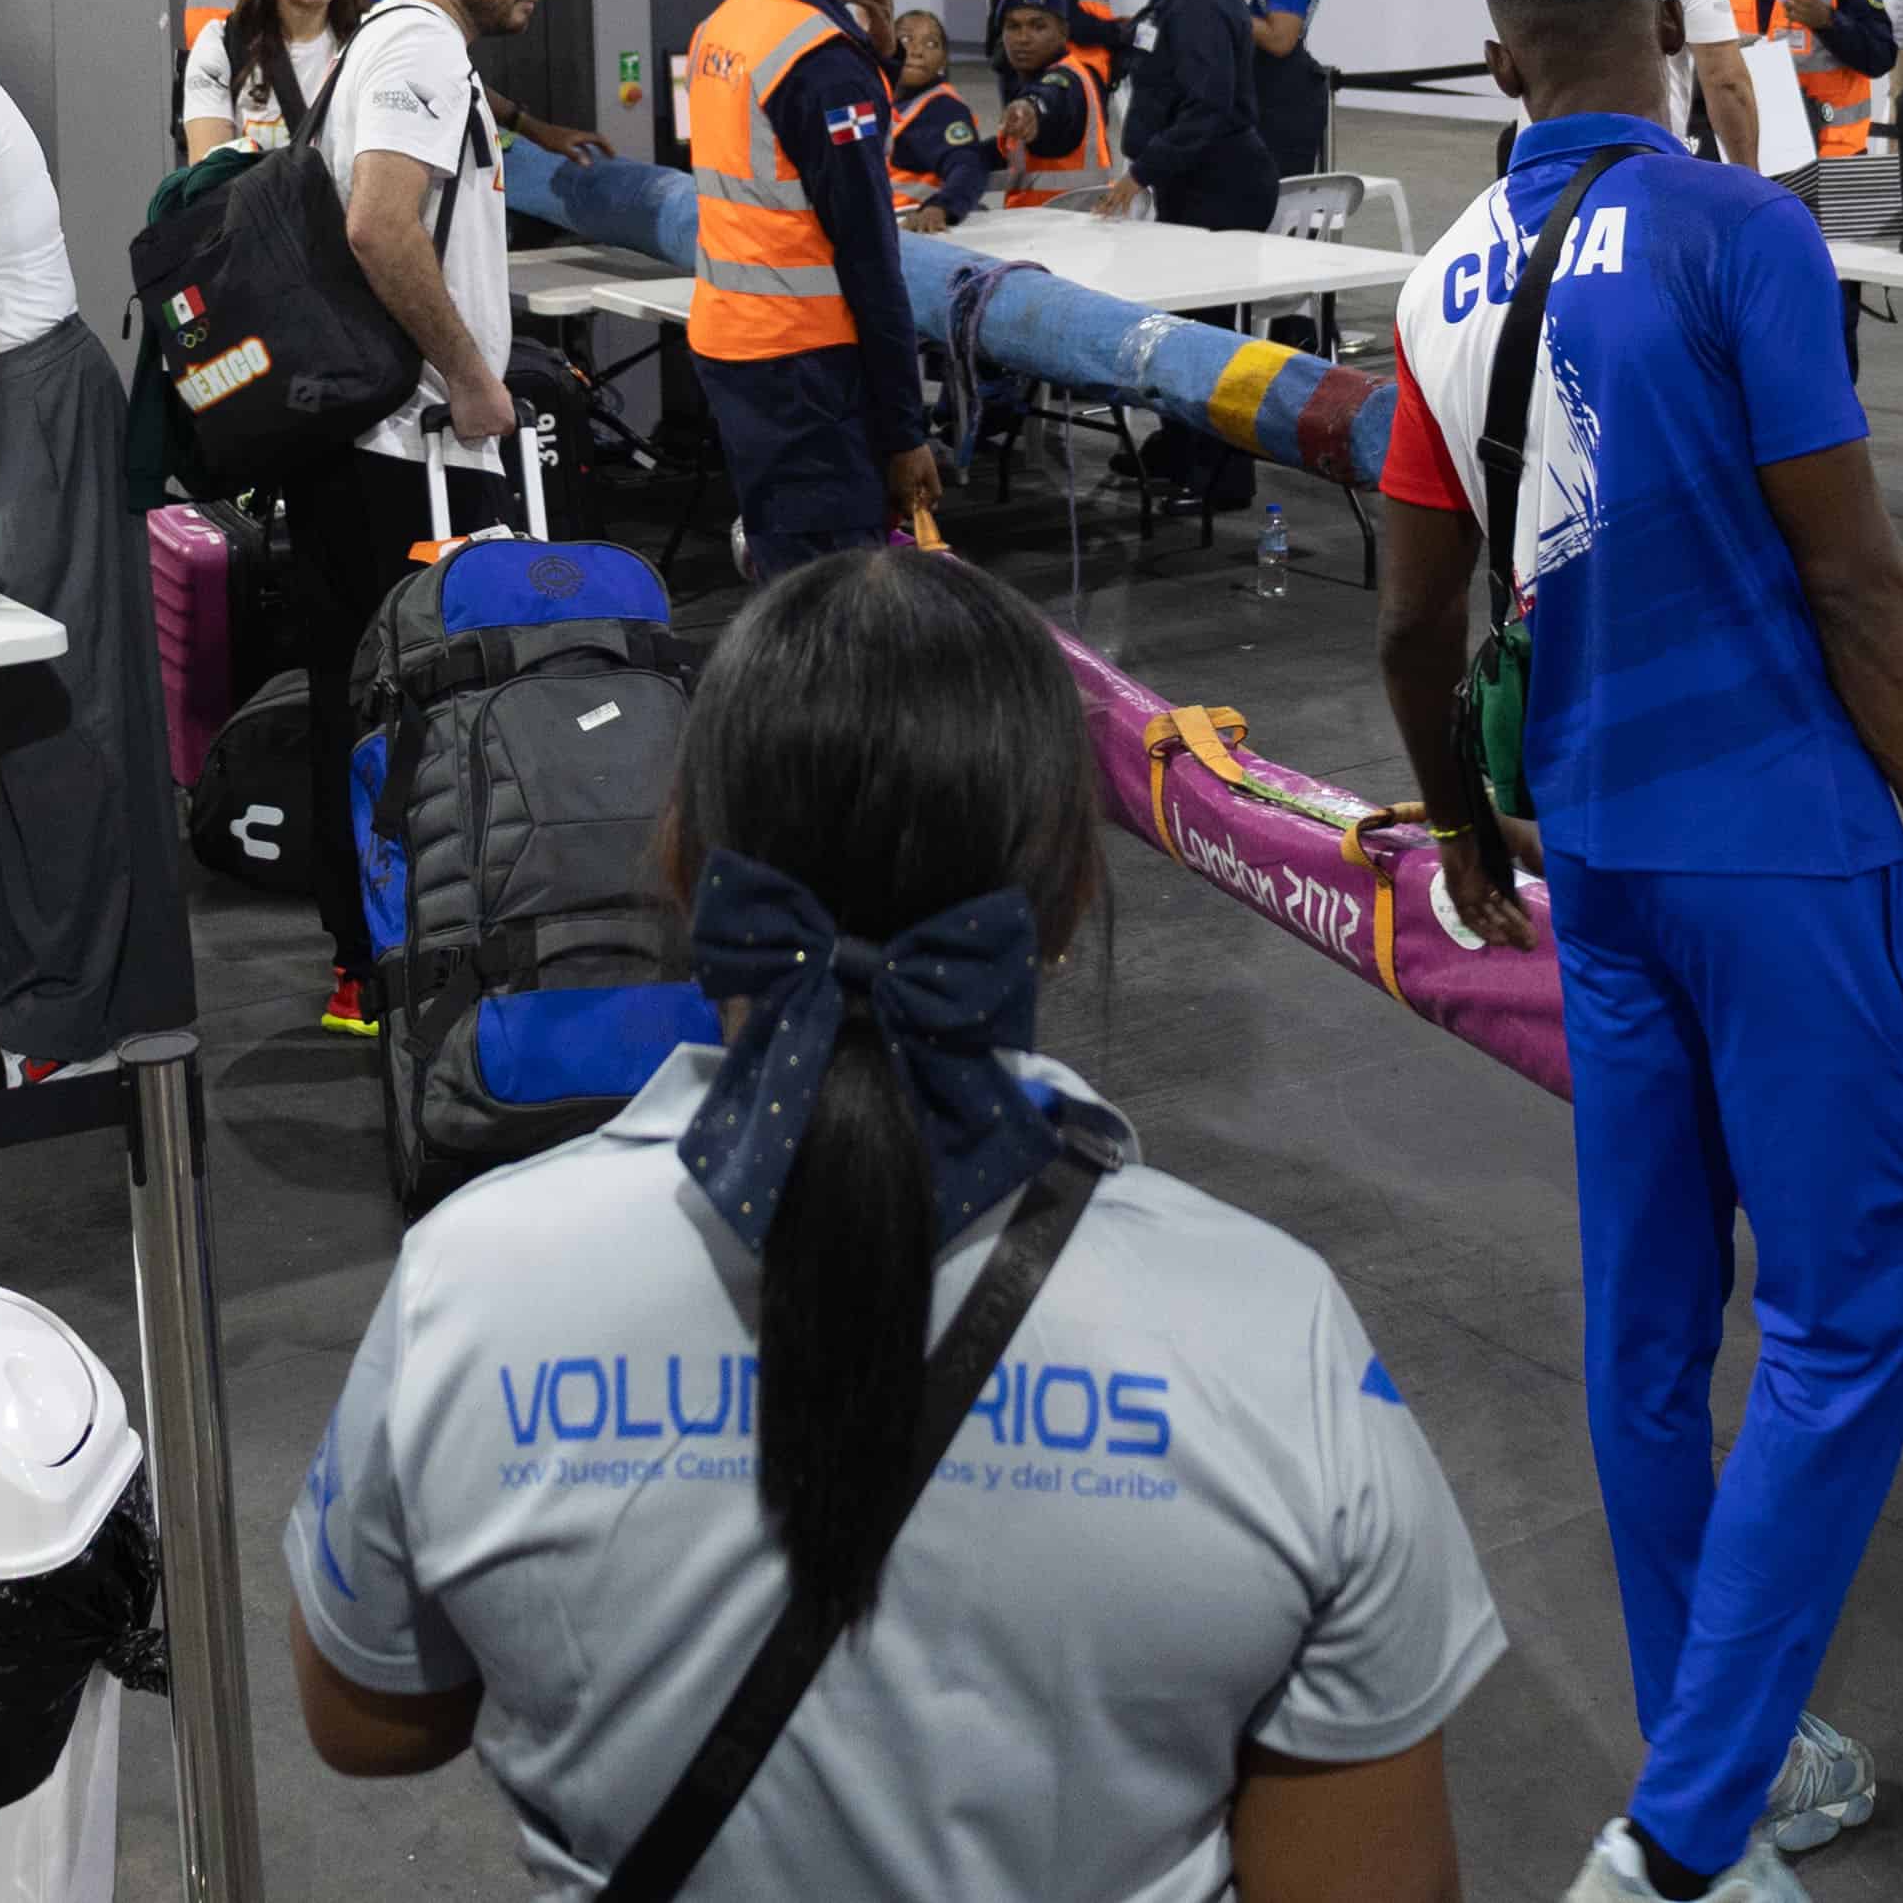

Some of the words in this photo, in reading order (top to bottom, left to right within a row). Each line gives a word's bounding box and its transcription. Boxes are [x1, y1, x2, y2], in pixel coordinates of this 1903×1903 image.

[1173, 801, 1283, 917] London
[1281, 864, 1362, 968] 2012
[499, 1354, 1171, 1458] VOLURIOS
[557, 1456, 665, 1487] Juegos
[984, 1465, 1003, 1491] y
[1011, 1463, 1062, 1492] del
[1072, 1467, 1178, 1500] Caribe
